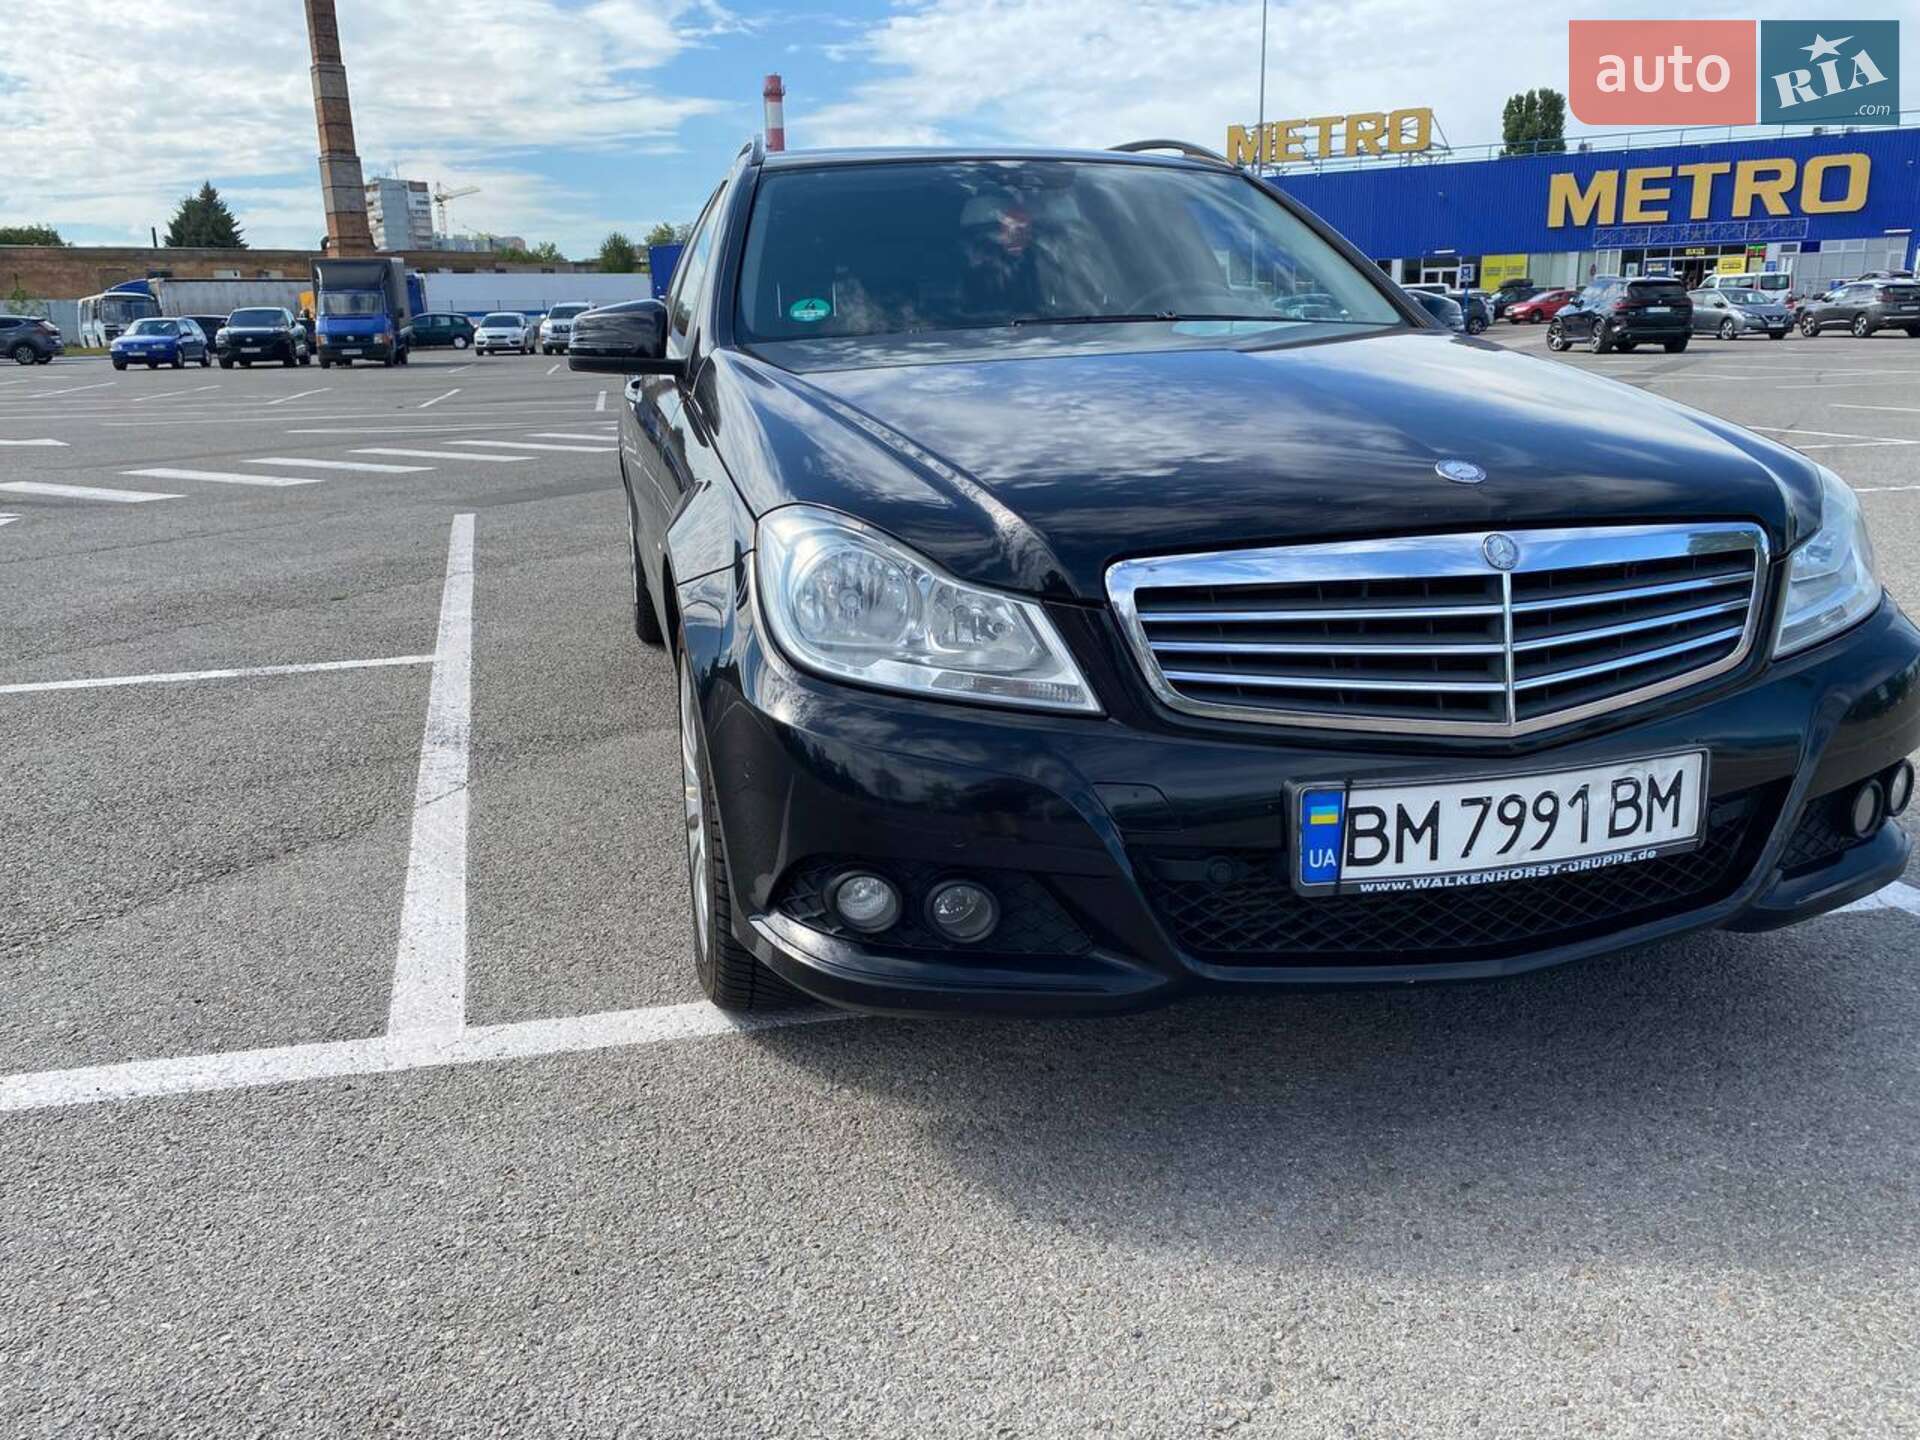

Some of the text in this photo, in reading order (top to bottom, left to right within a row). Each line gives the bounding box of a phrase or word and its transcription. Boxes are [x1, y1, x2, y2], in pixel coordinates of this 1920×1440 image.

[1227, 107, 1433, 167] METRO
[1547, 153, 1872, 228] METRO
[1345, 769, 1684, 868] BM 7991 BM
[1309, 848, 1337, 870] UA
